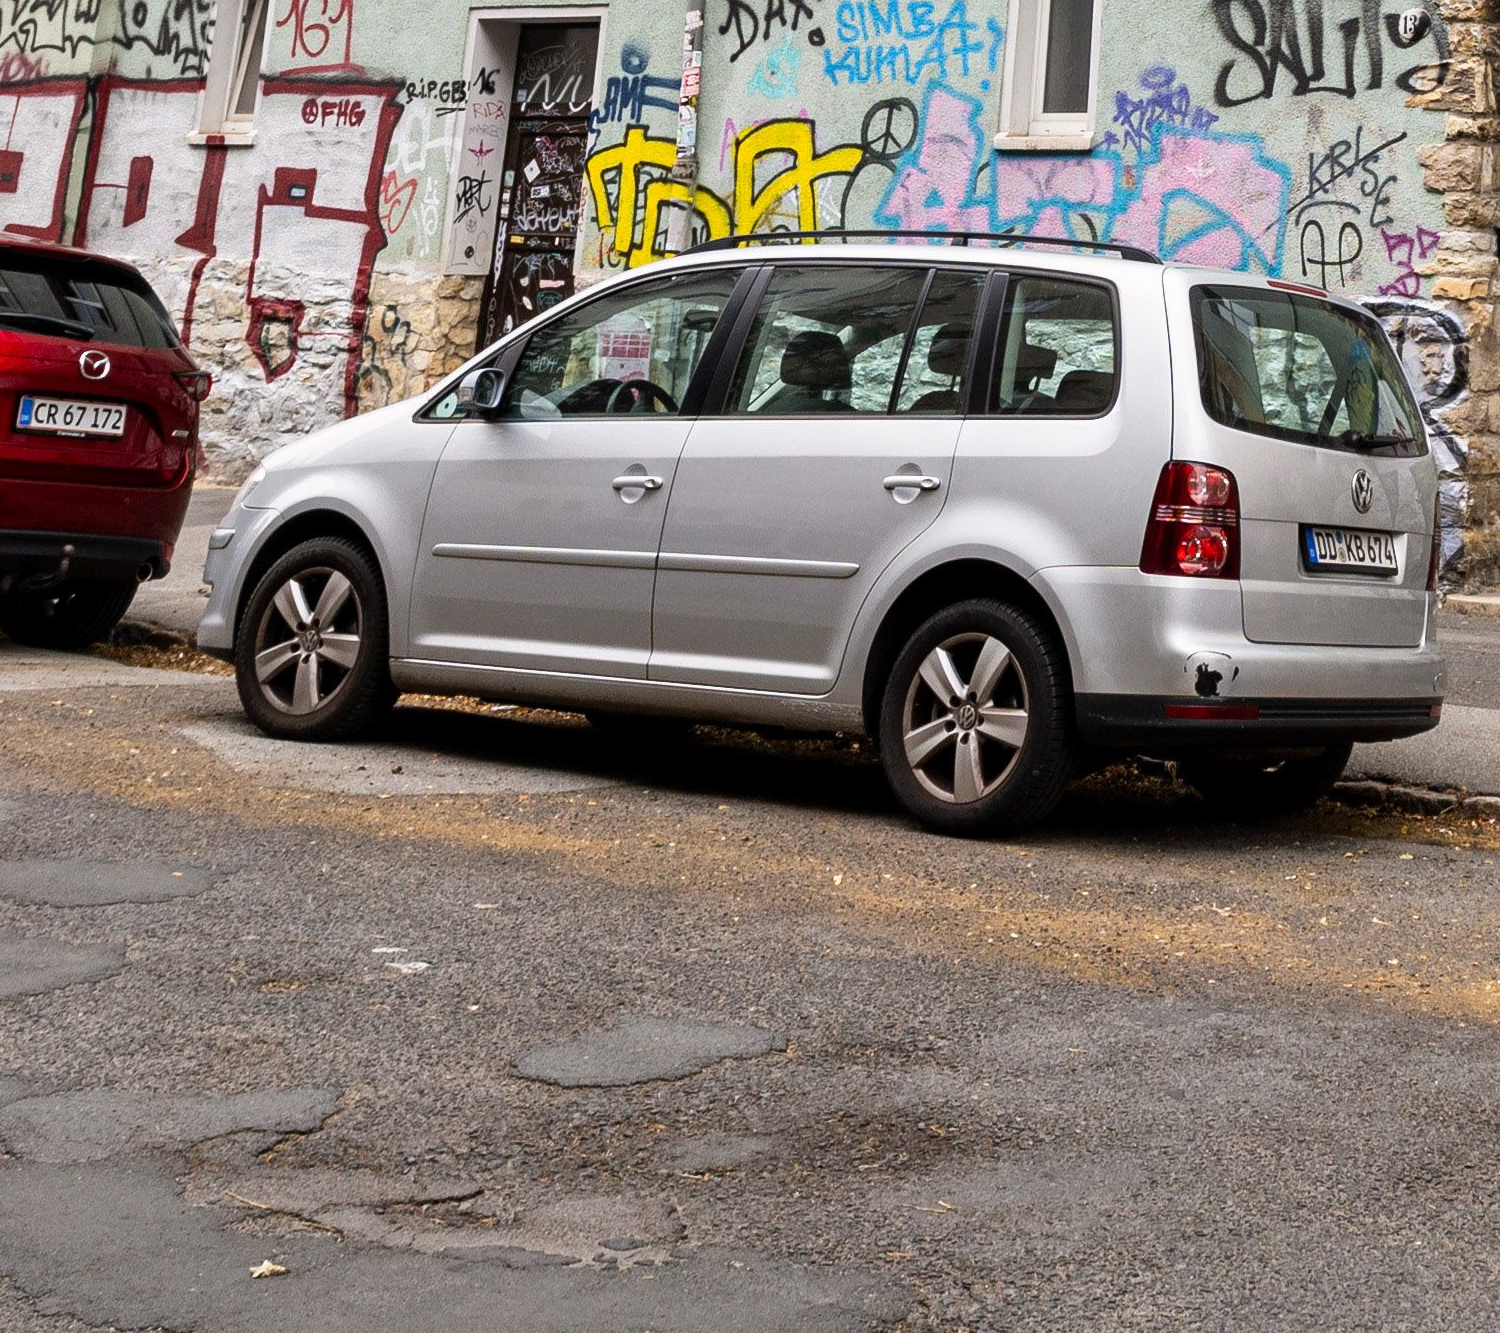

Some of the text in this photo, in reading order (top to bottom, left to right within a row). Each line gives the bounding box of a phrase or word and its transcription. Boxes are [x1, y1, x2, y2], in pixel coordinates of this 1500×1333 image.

[1403, 14, 1419, 34] 13
[320, 99, 366, 127] FHG
[34, 402, 123, 430] CR 67 172
[1315, 531, 1393, 566] DD KB 674
